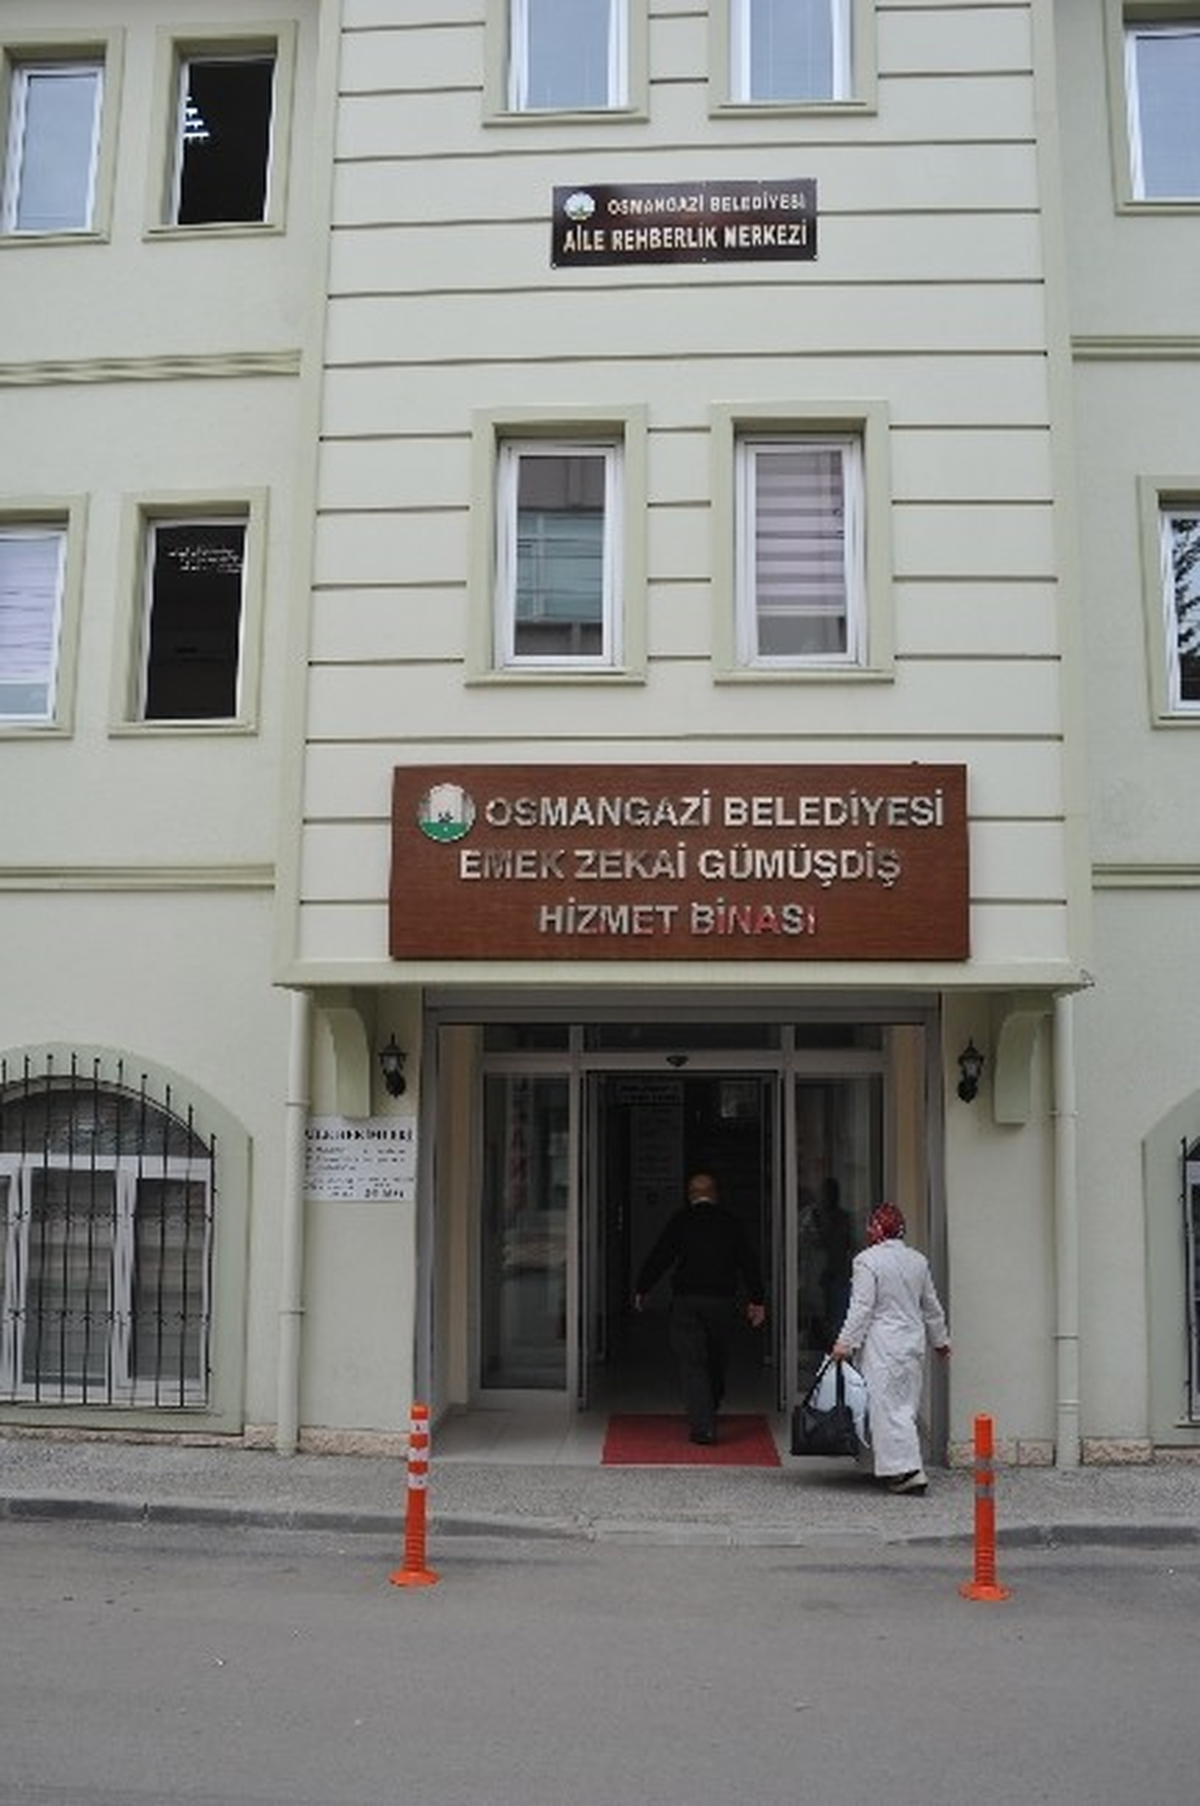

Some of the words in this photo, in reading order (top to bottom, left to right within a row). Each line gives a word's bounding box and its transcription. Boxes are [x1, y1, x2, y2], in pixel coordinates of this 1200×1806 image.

[563, 224, 604, 252] AİLE
[611, 221, 718, 251] REHBERLİK
[485, 789, 711, 827] OSMANGAZİ
[724, 789, 944, 827] BELEDİYESİ
[459, 849, 565, 879] EMEK
[574, 841, 686, 879] ZEKAİ
[698, 842, 901, 888] GÜMÜŞDİŞ
[539, 897, 678, 934] HİZMET
[691, 897, 817, 934] BİNASI
